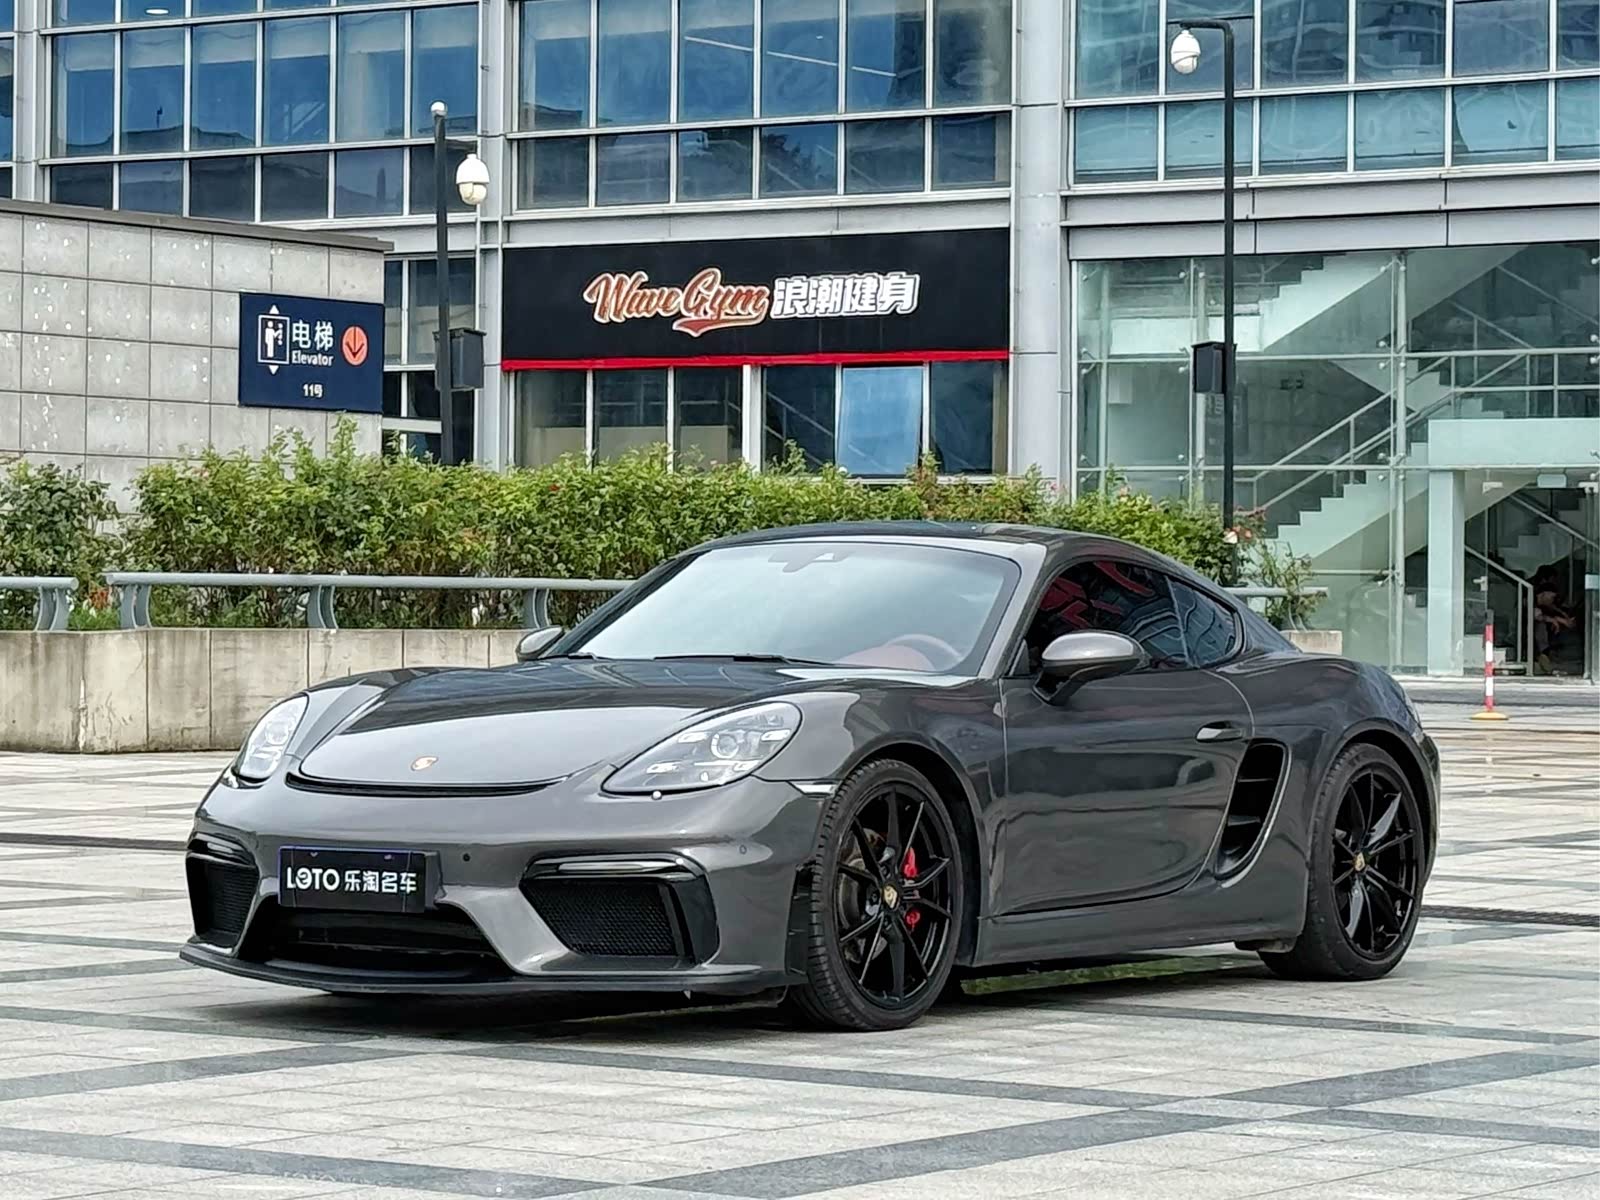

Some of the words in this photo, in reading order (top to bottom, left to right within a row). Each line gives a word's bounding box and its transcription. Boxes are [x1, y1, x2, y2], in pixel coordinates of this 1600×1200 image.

[583, 271, 682, 323] Wave
[676, 268, 770, 337] Gym
[771, 272, 920, 319] 浪潮健身
[292, 319, 334, 351] 电梯
[292, 350, 334, 366] Elevator
[303, 384, 323, 398] 11号
[286, 866, 340, 891] LOTO
[344, 870, 417, 894] 乐淘名车
